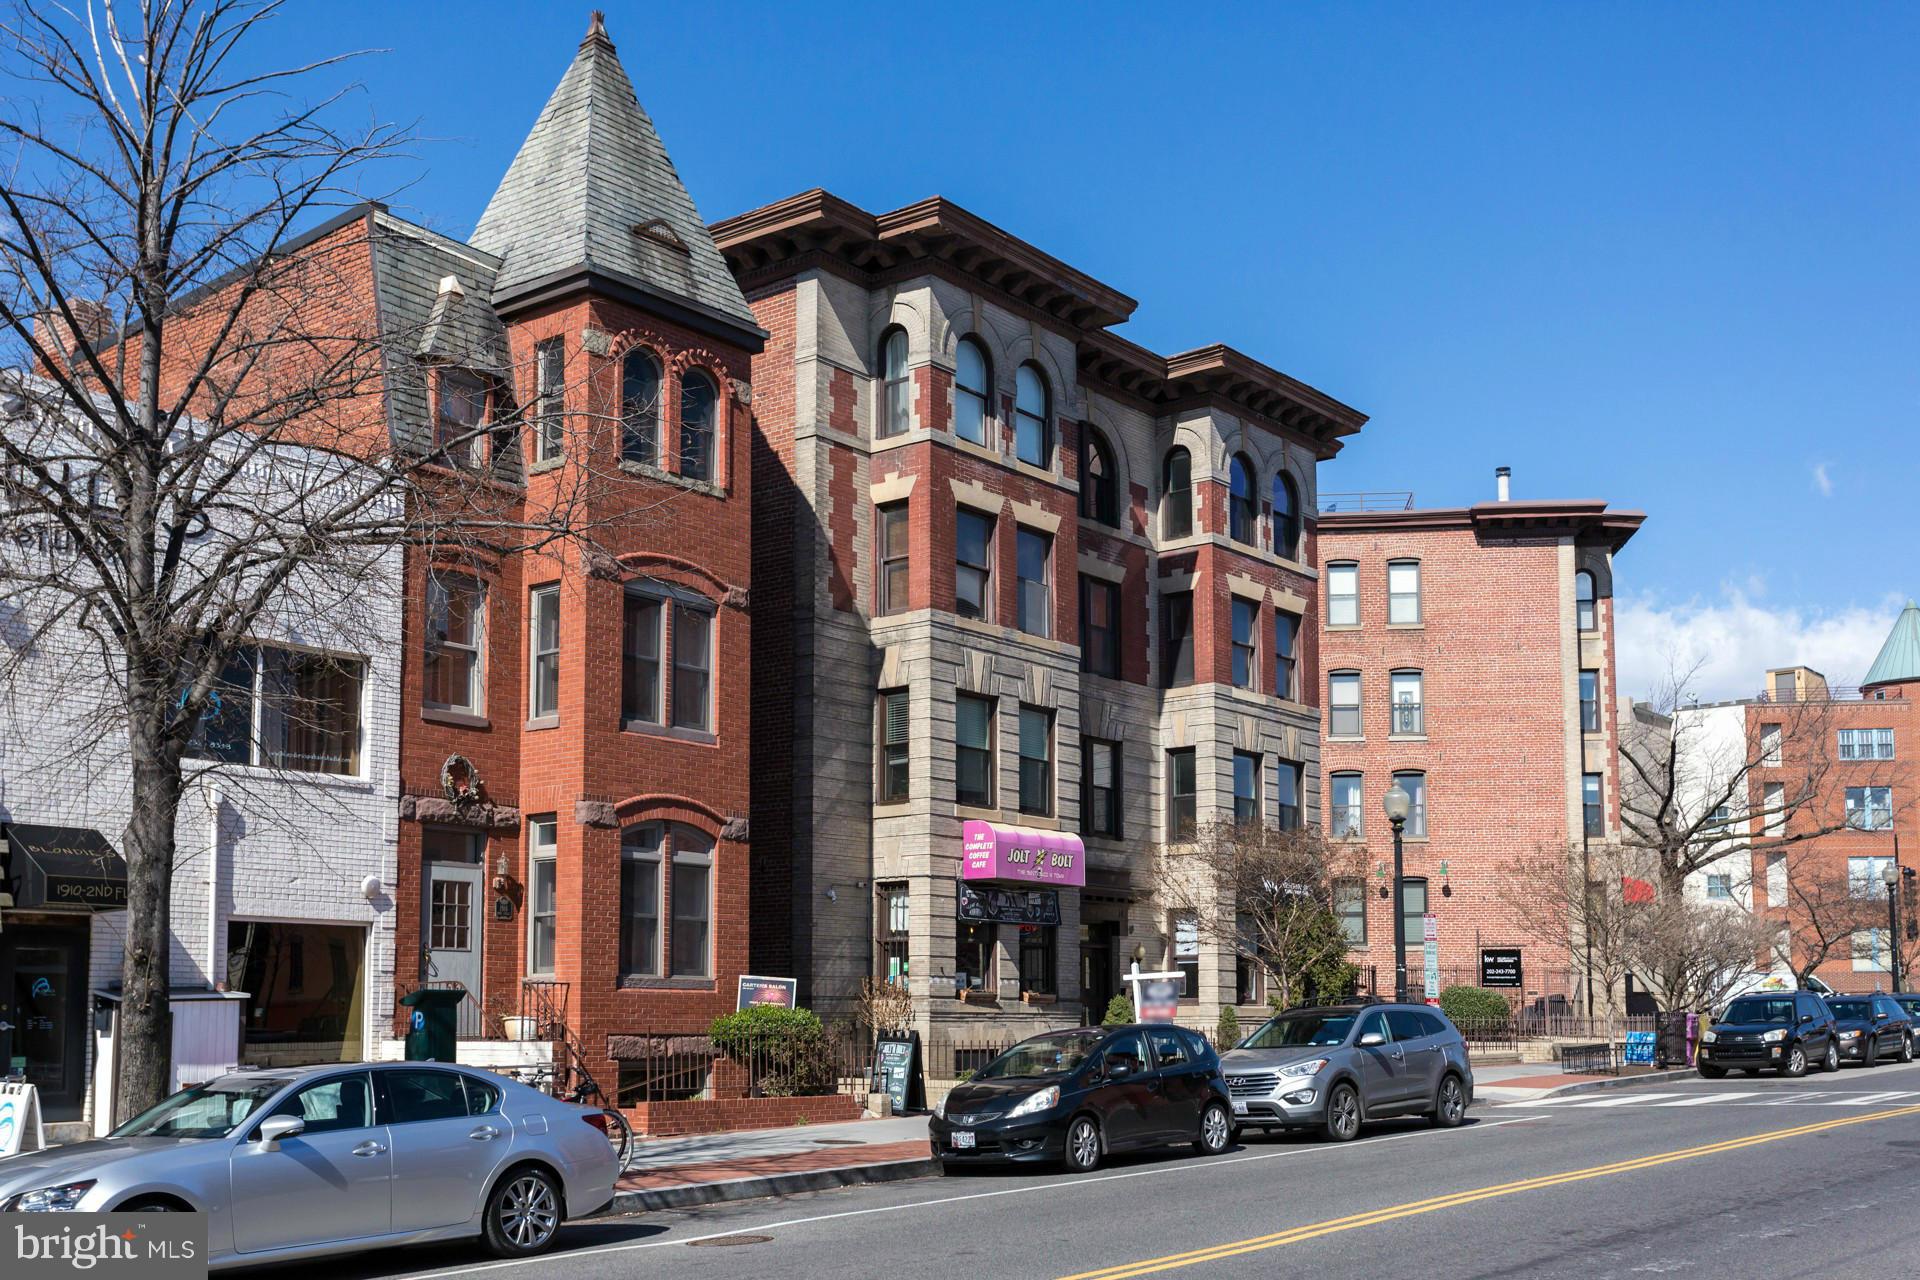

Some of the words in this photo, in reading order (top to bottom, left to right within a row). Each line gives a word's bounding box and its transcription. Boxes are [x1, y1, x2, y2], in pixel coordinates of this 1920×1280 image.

[974, 833, 985, 841] THE
[965, 841, 993, 851] COMPLETE
[968, 851, 990, 860] COFFEE
[1007, 848, 1031, 864] JOLT
[1051, 853, 1074, 868] BOLT
[971, 860, 987, 869] CAFE
[57, 883, 113, 898] 1910-2ND
[415, 1011, 424, 1029] P
